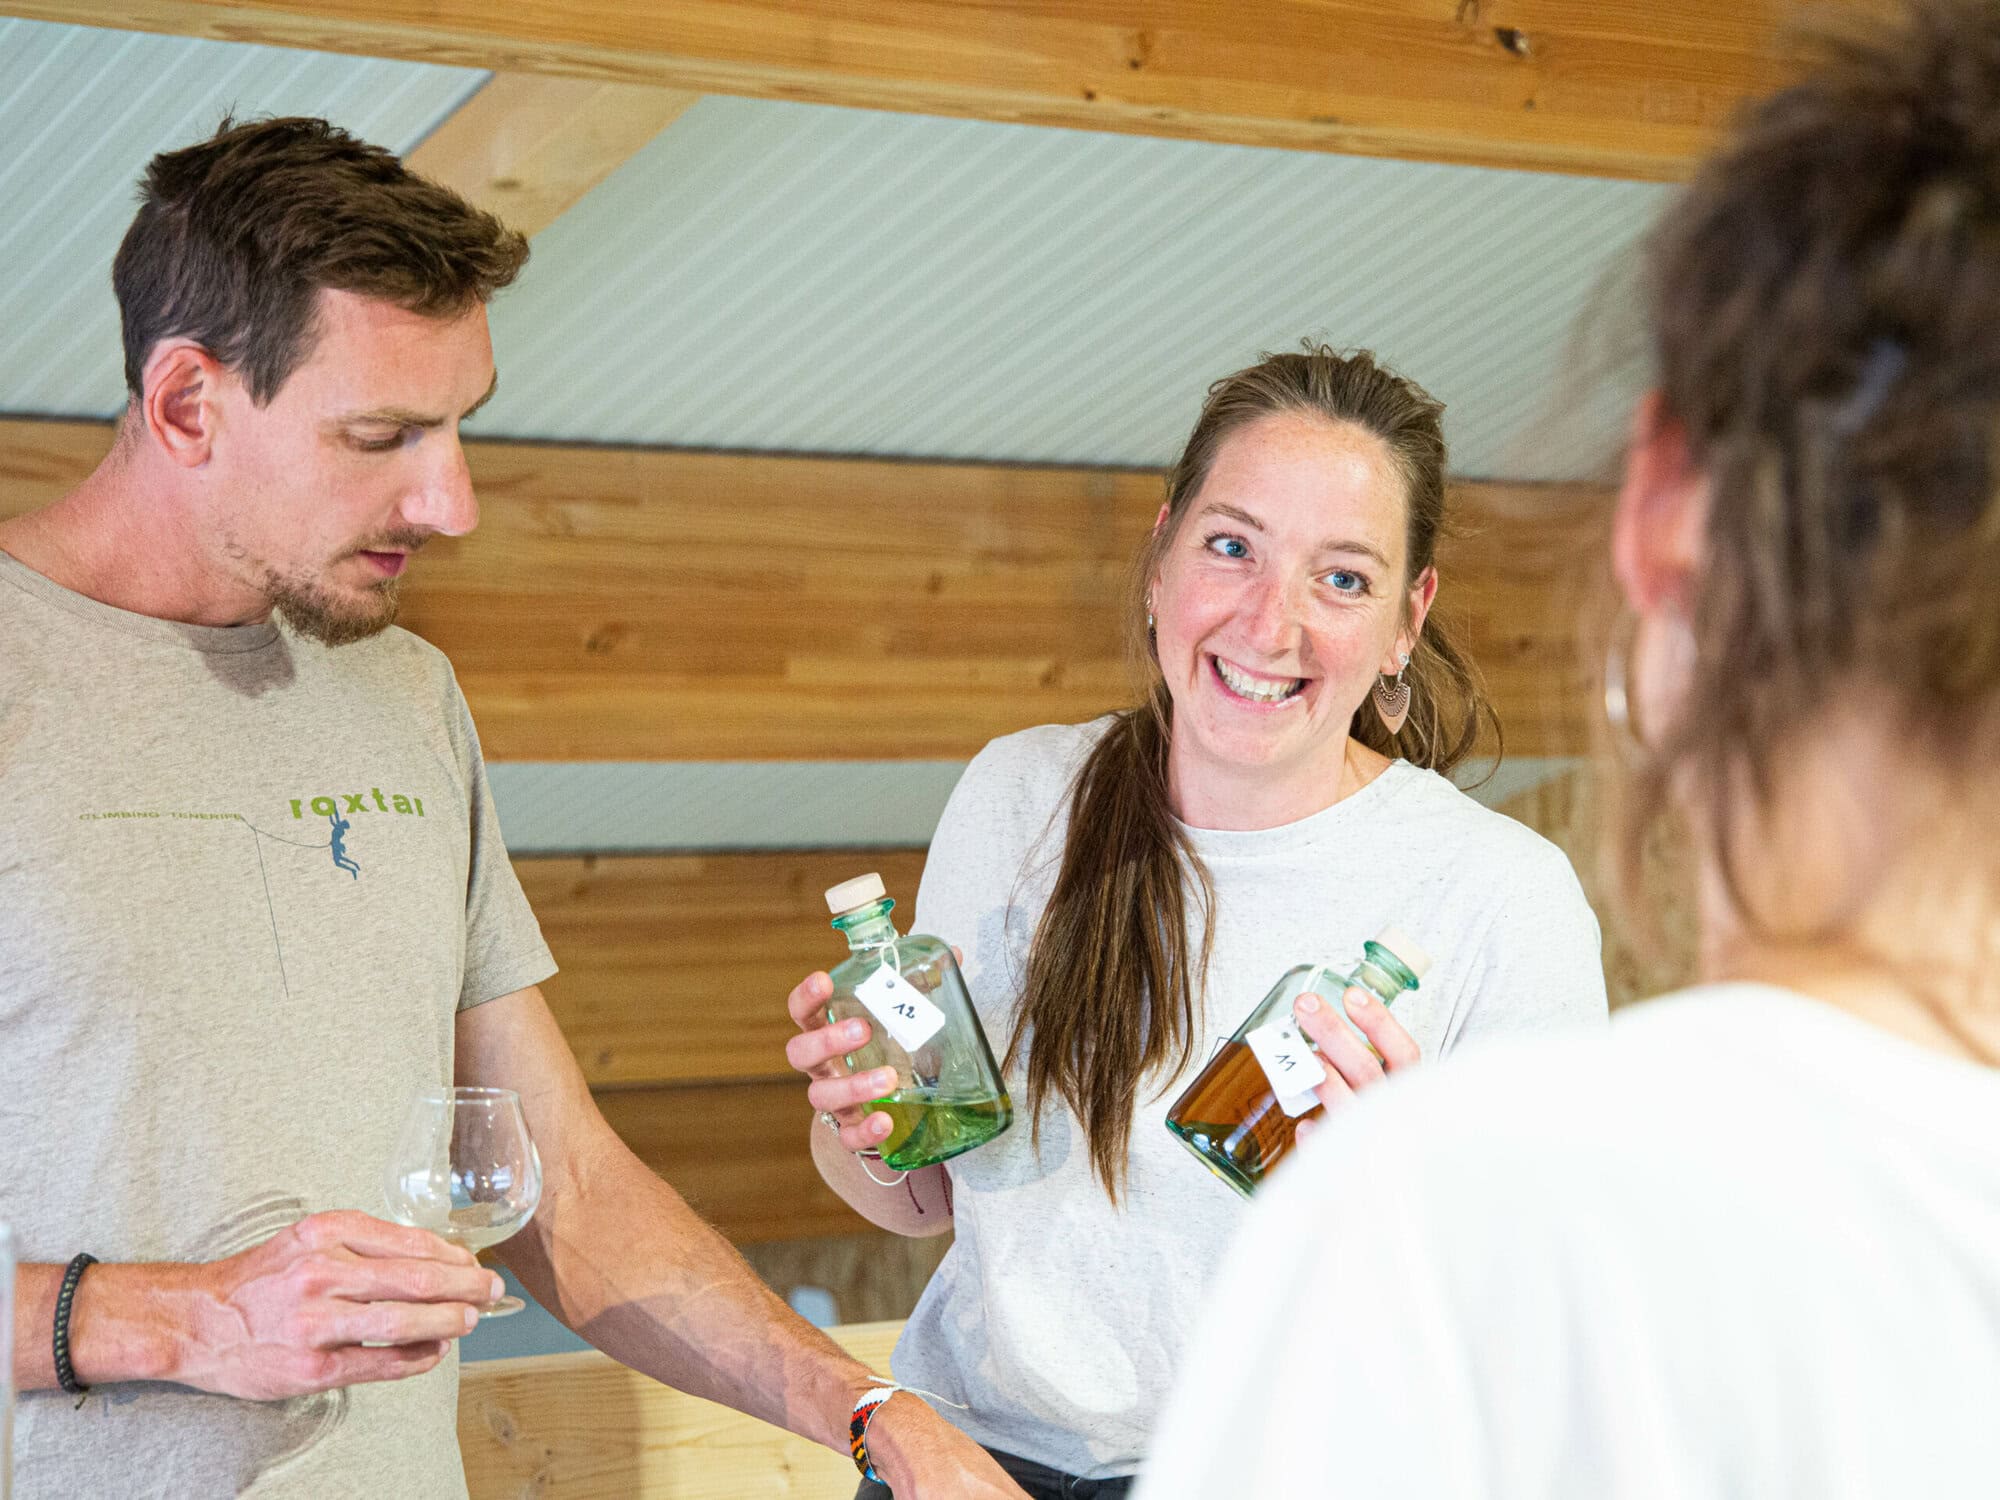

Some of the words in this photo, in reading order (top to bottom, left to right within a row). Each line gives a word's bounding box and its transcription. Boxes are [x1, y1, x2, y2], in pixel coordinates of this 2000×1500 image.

[79, 811, 161, 820] CLIMBING
[891, 1002, 916, 1020] 12
[1274, 1054, 1297, 1073] 11
